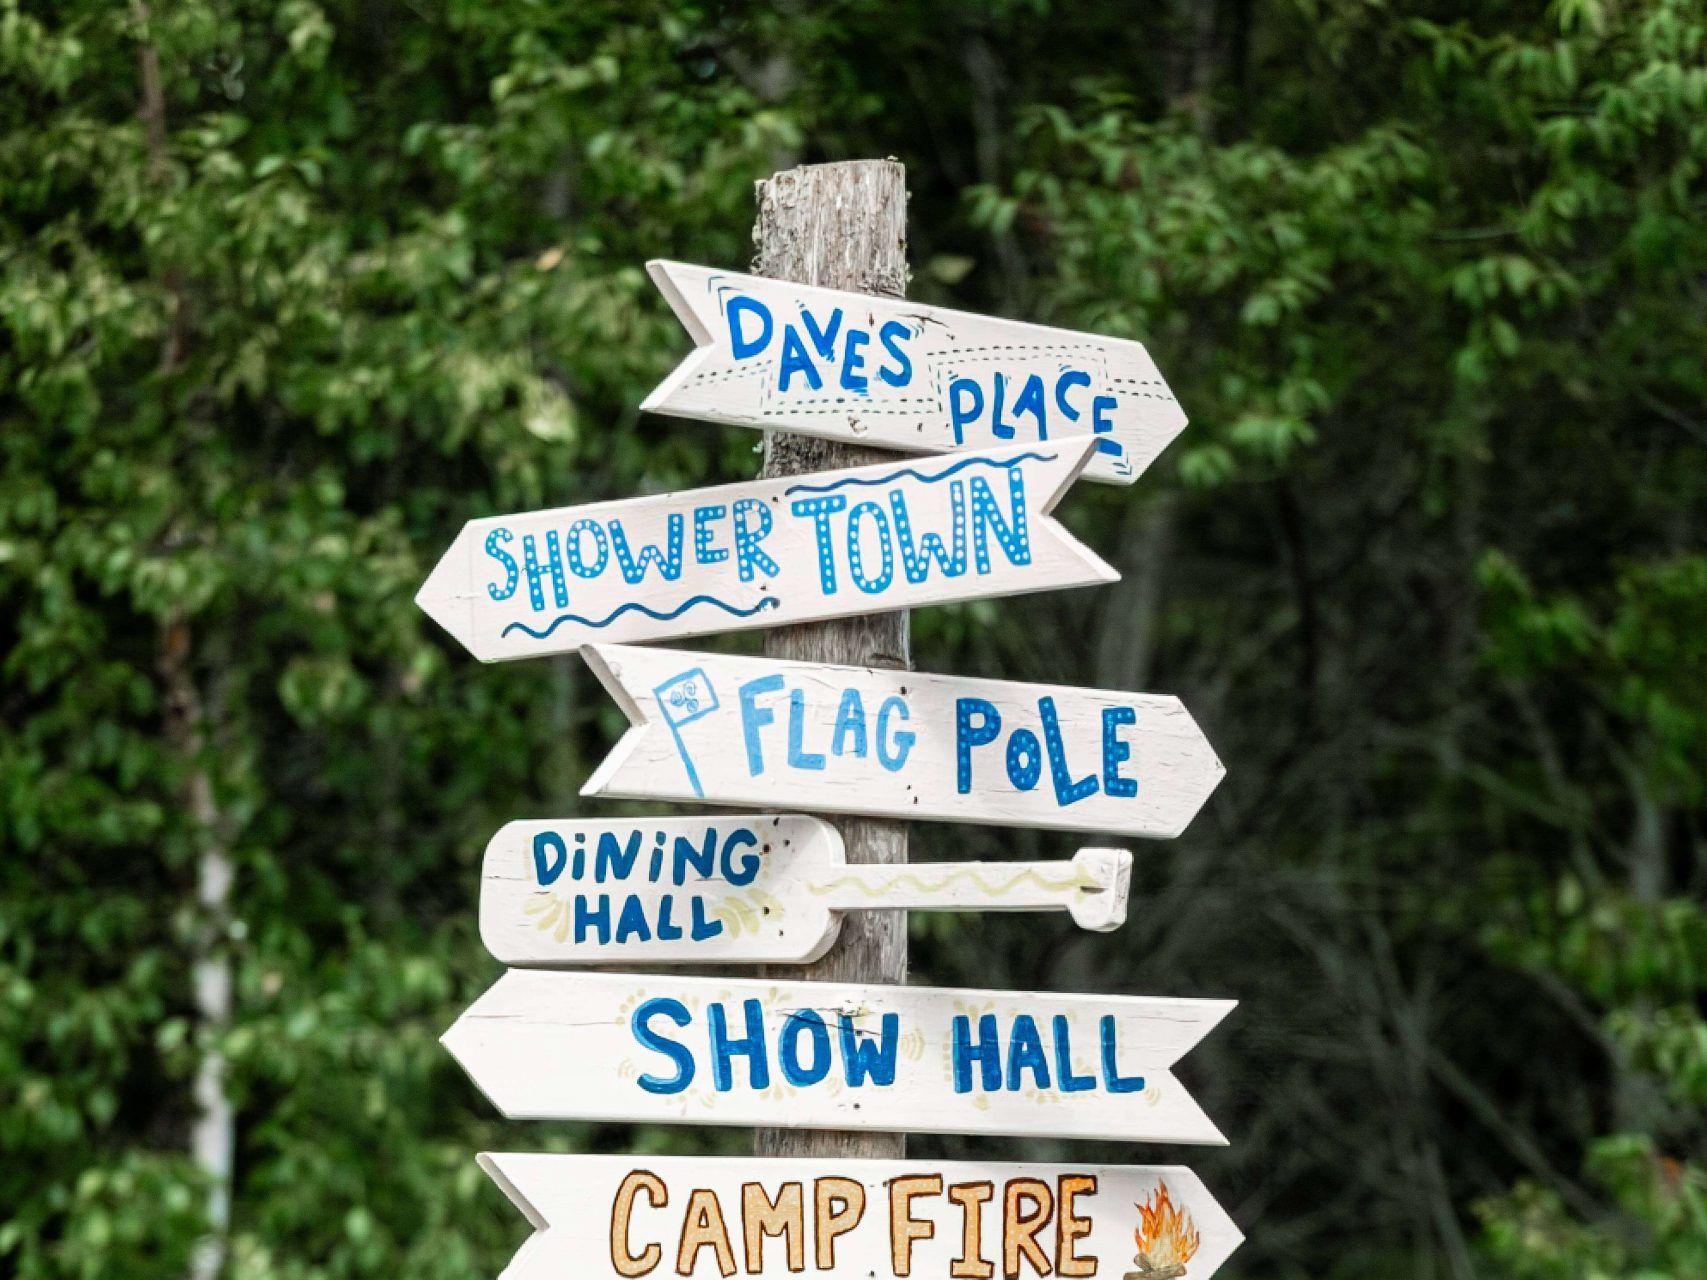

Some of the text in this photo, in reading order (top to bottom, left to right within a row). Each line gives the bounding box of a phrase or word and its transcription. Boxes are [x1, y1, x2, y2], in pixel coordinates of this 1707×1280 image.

[726, 295, 1123, 456] DAVES PLACE
[485, 467, 1033, 611] SHOWER TOWN
[738, 674, 1138, 808] FLAG POLE
[574, 894, 723, 945] HALL
[631, 997, 1146, 1095] SHOW HALL
[609, 1170, 1099, 1280] CAMP FIRE
